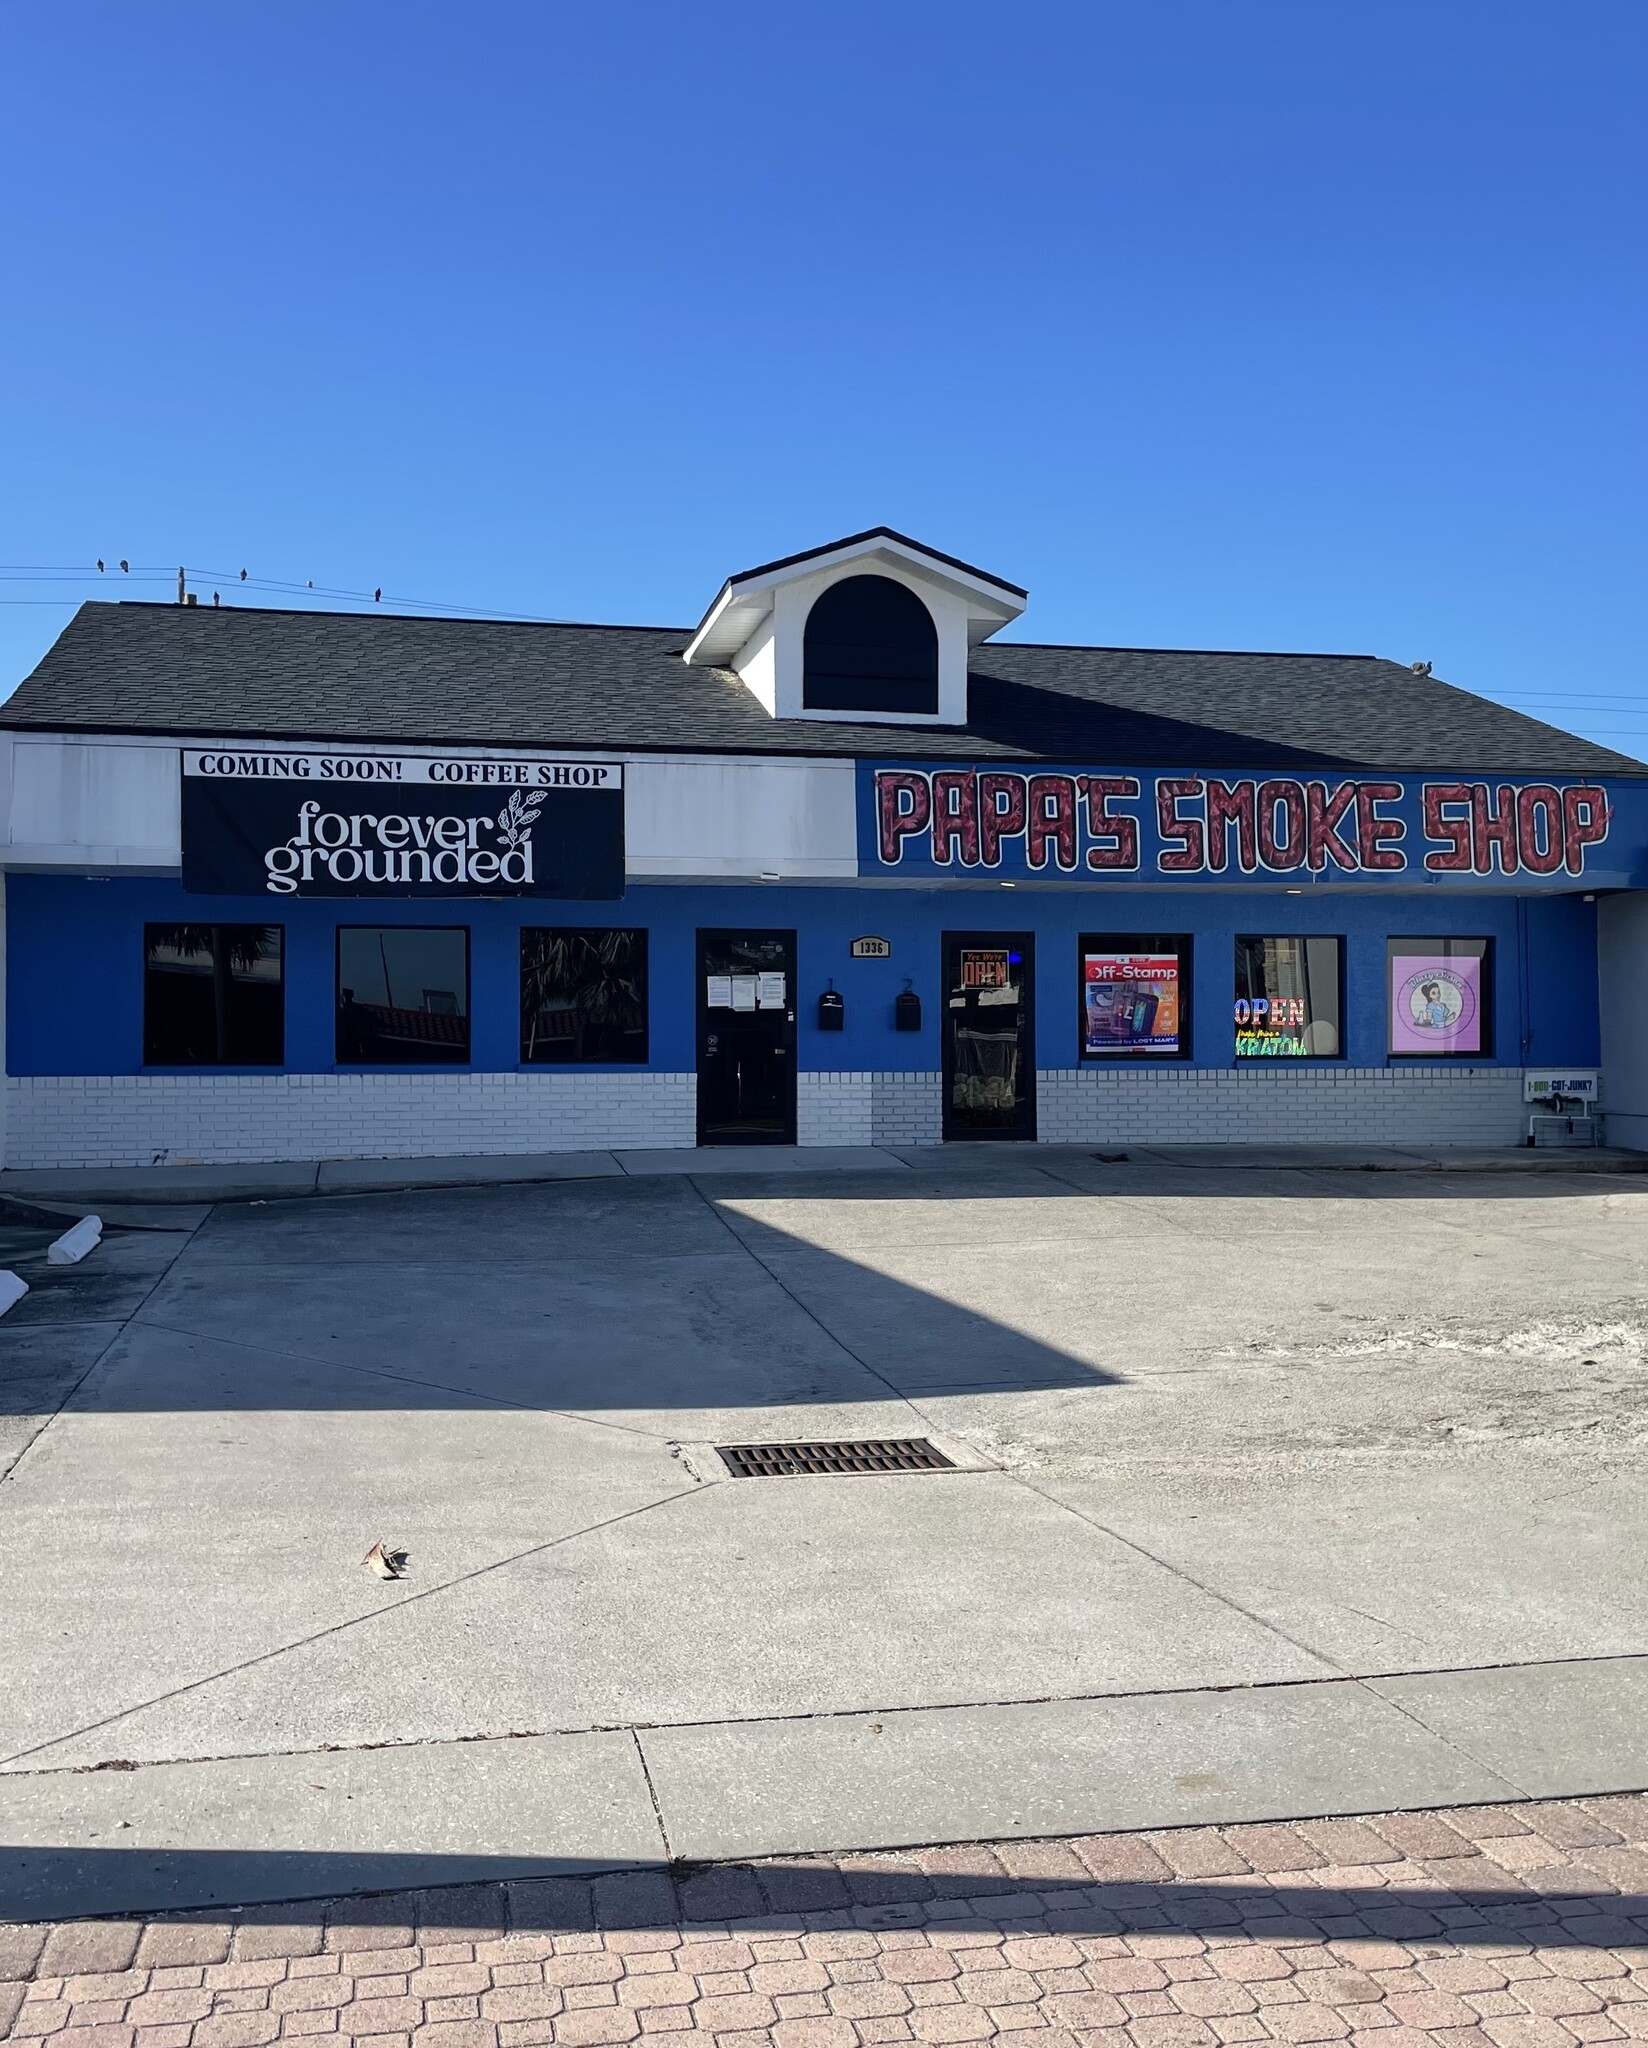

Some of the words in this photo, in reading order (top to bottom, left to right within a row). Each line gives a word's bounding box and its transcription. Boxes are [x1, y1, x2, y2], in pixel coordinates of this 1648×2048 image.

[198, 754, 311, 778] COMING
[320, 758, 403, 781] SOON!
[428, 762, 529, 784] COFFEE
[537, 765, 608, 787] SHOP
[297, 800, 494, 850] forever
[874, 769, 1141, 872] PAPA'S
[1155, 777, 1408, 873] SMOKE
[1421, 782, 1611, 877] SHOP
[264, 838, 535, 893] grounded
[860, 941, 883, 954] 1336
[964, 961, 1007, 986] OPEN
[1088, 965, 1177, 980] Off-Stamp
[1234, 998, 1305, 1026] OPEN
[1235, 1035, 1307, 1056] KRATOM
[1528, 1080, 1593, 1092] 1-800-GOT-JUNK?
